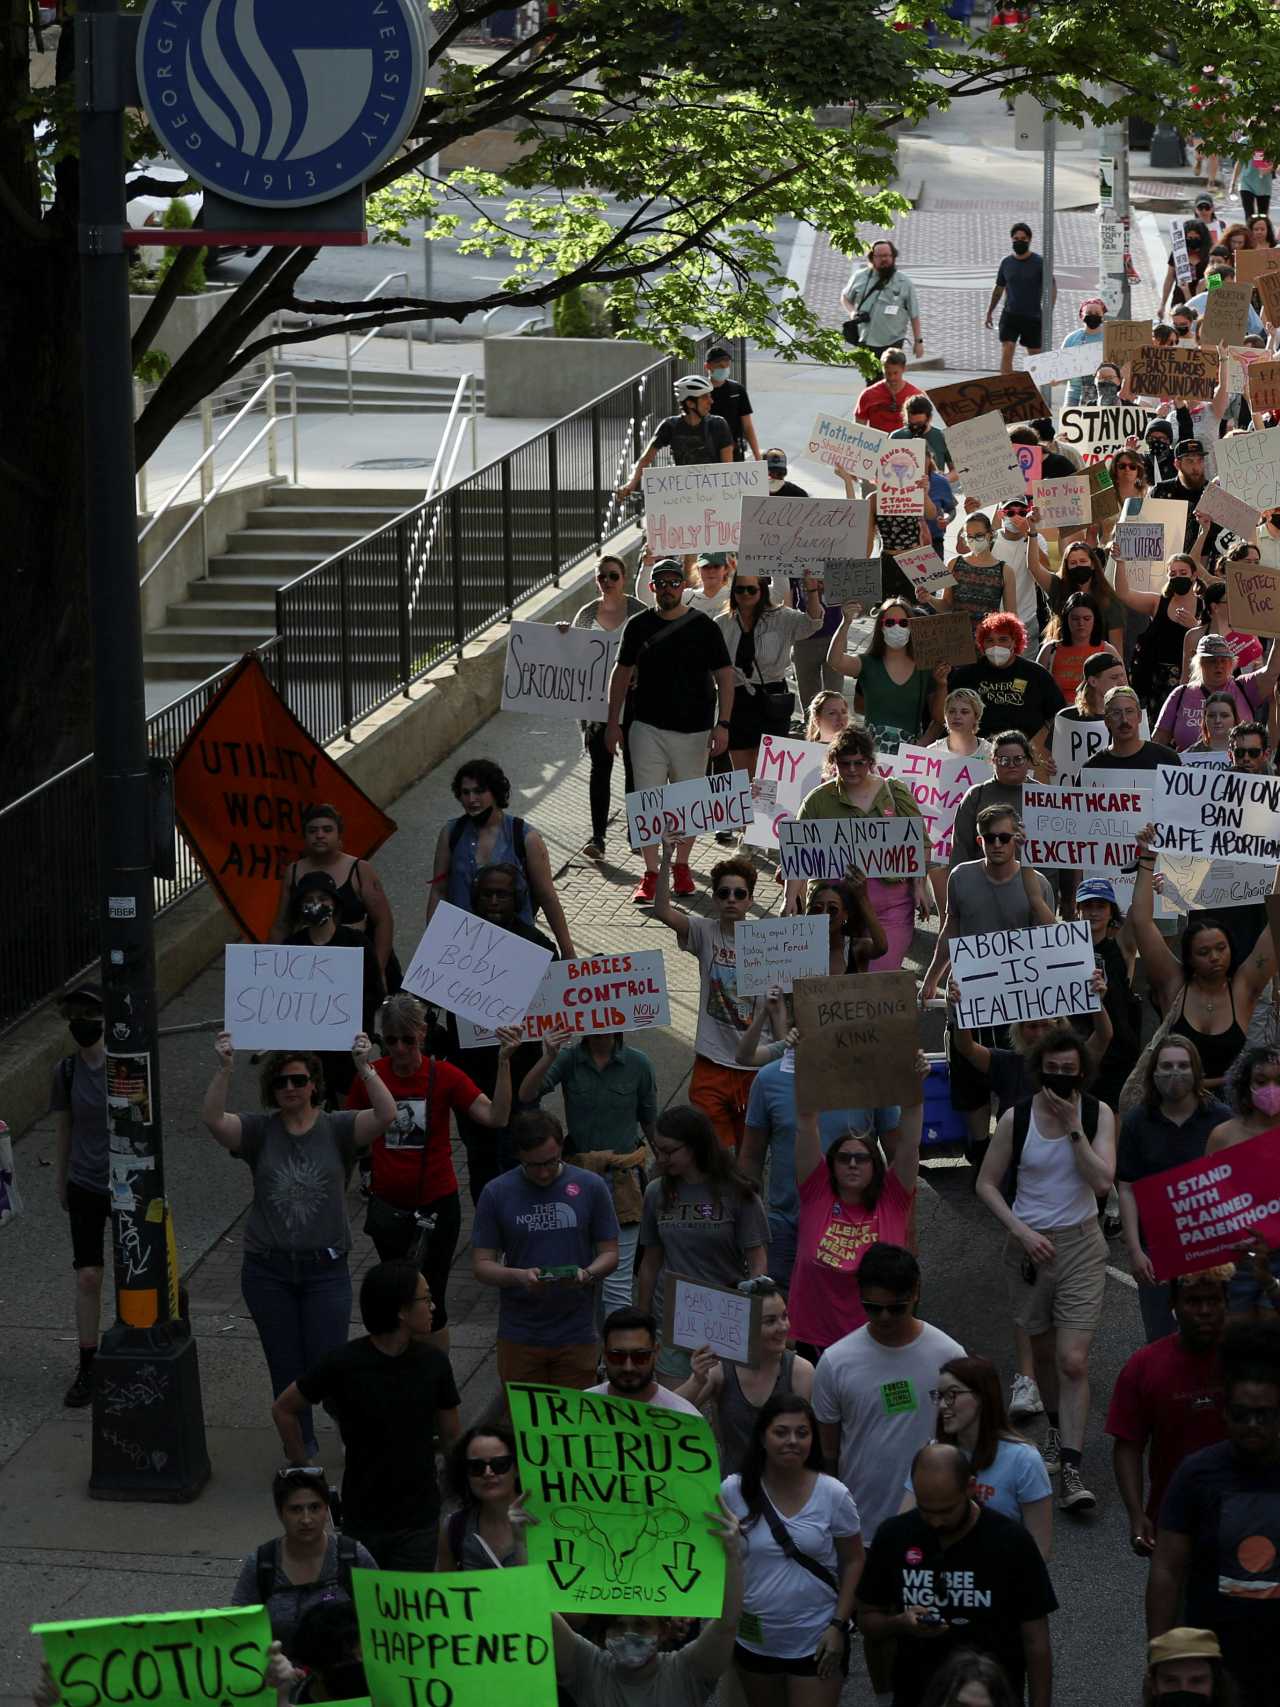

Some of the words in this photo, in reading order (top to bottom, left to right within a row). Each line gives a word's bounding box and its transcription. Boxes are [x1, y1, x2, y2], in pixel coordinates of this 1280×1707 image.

[242, 168, 318, 192] 1913
[819, 420, 882, 452] Motherhood
[1061, 409, 1120, 443] STAY
[645, 471, 759, 495] EXPECTATIONS
[649, 514, 700, 550] HOLY
[200, 739, 319, 789] UTILITY
[760, 746, 806, 784] MY
[1162, 769, 1208, 796] YOU
[1210, 773, 1250, 802] CAN
[689, 791, 752, 832] CHOICE
[1037, 815, 1077, 835] FOR
[1088, 816, 1134, 838] ALL
[1200, 803, 1243, 828] BAN
[854, 821, 890, 842] NOT
[1154, 823, 1203, 852] SAFE
[780, 844, 851, 879] WOMAN
[860, 844, 919, 875] WOMB
[451, 917, 508, 951] MY
[954, 921, 1090, 963] ABORTION
[252, 950, 334, 984] FUCK
[438, 943, 508, 979] BODY
[1002, 958, 1039, 986] IS
[408, 967, 445, 995] MY
[562, 978, 659, 1007] CONTROL
[234, 986, 351, 1026] SCOTUS
[817, 1000, 907, 1025] BREEDING
[959, 980, 1097, 1028] HEALTHCARE
[835, 1029, 880, 1048] KINK
[1167, 1185, 1176, 1198] I
[1178, 1163, 1233, 1197] STAND
[532, 1204, 556, 1215] THE
[1171, 1184, 1220, 1214] WITH
[1175, 1192, 1254, 1230] PLANNED
[515, 1214, 557, 1226] NORTH
[527, 1223, 557, 1233] FACE
[815, 1250, 843, 1269] YES.
[509, 1383, 683, 1432] TRANS
[519, 1432, 712, 1474] UTERUS
[540, 1471, 678, 1508] HAVER
[573, 1584, 668, 1603] #DUDERUS
[902, 1569, 936, 1589] WE
[374, 1585, 481, 1623] WHAT
[370, 1627, 549, 1666] HAPPENED
[58, 1639, 268, 1702] SCOTUS
[399, 1674, 454, 1707] TO
